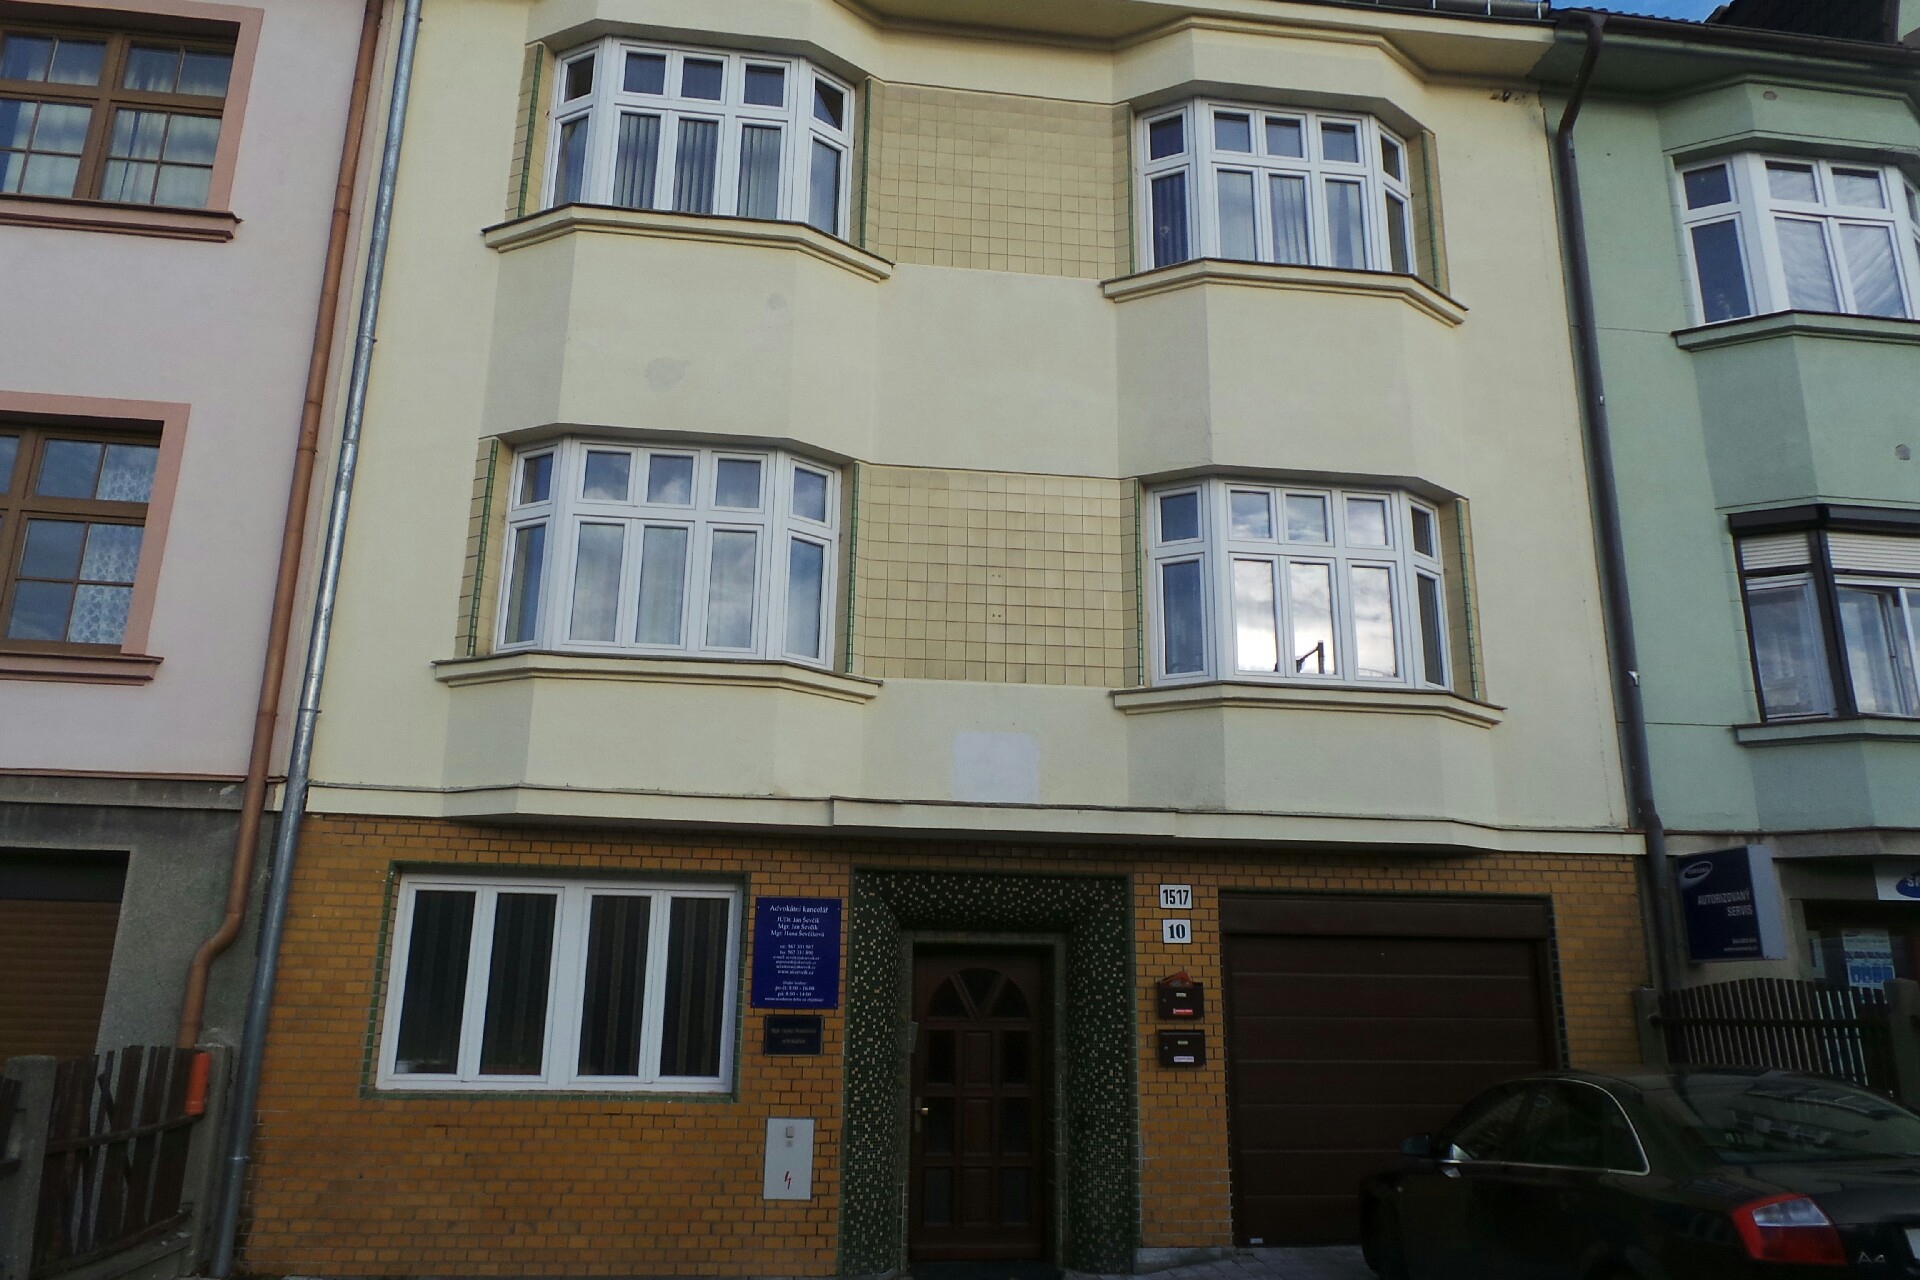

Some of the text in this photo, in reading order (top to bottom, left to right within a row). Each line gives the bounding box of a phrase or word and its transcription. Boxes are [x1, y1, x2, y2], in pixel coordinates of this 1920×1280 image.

[1163, 889, 1189, 905] 1517
[769, 904, 829, 913] Advokátní kancelář
[1727, 904, 1753, 917] SERVIS
[802, 916, 820, 924] Ševčík
[801, 923, 818, 931] Ševčík
[1168, 924, 1186, 939] 10
[798, 930, 825, 938] Ševčíková
[1857, 1250, 1887, 1264] A4
